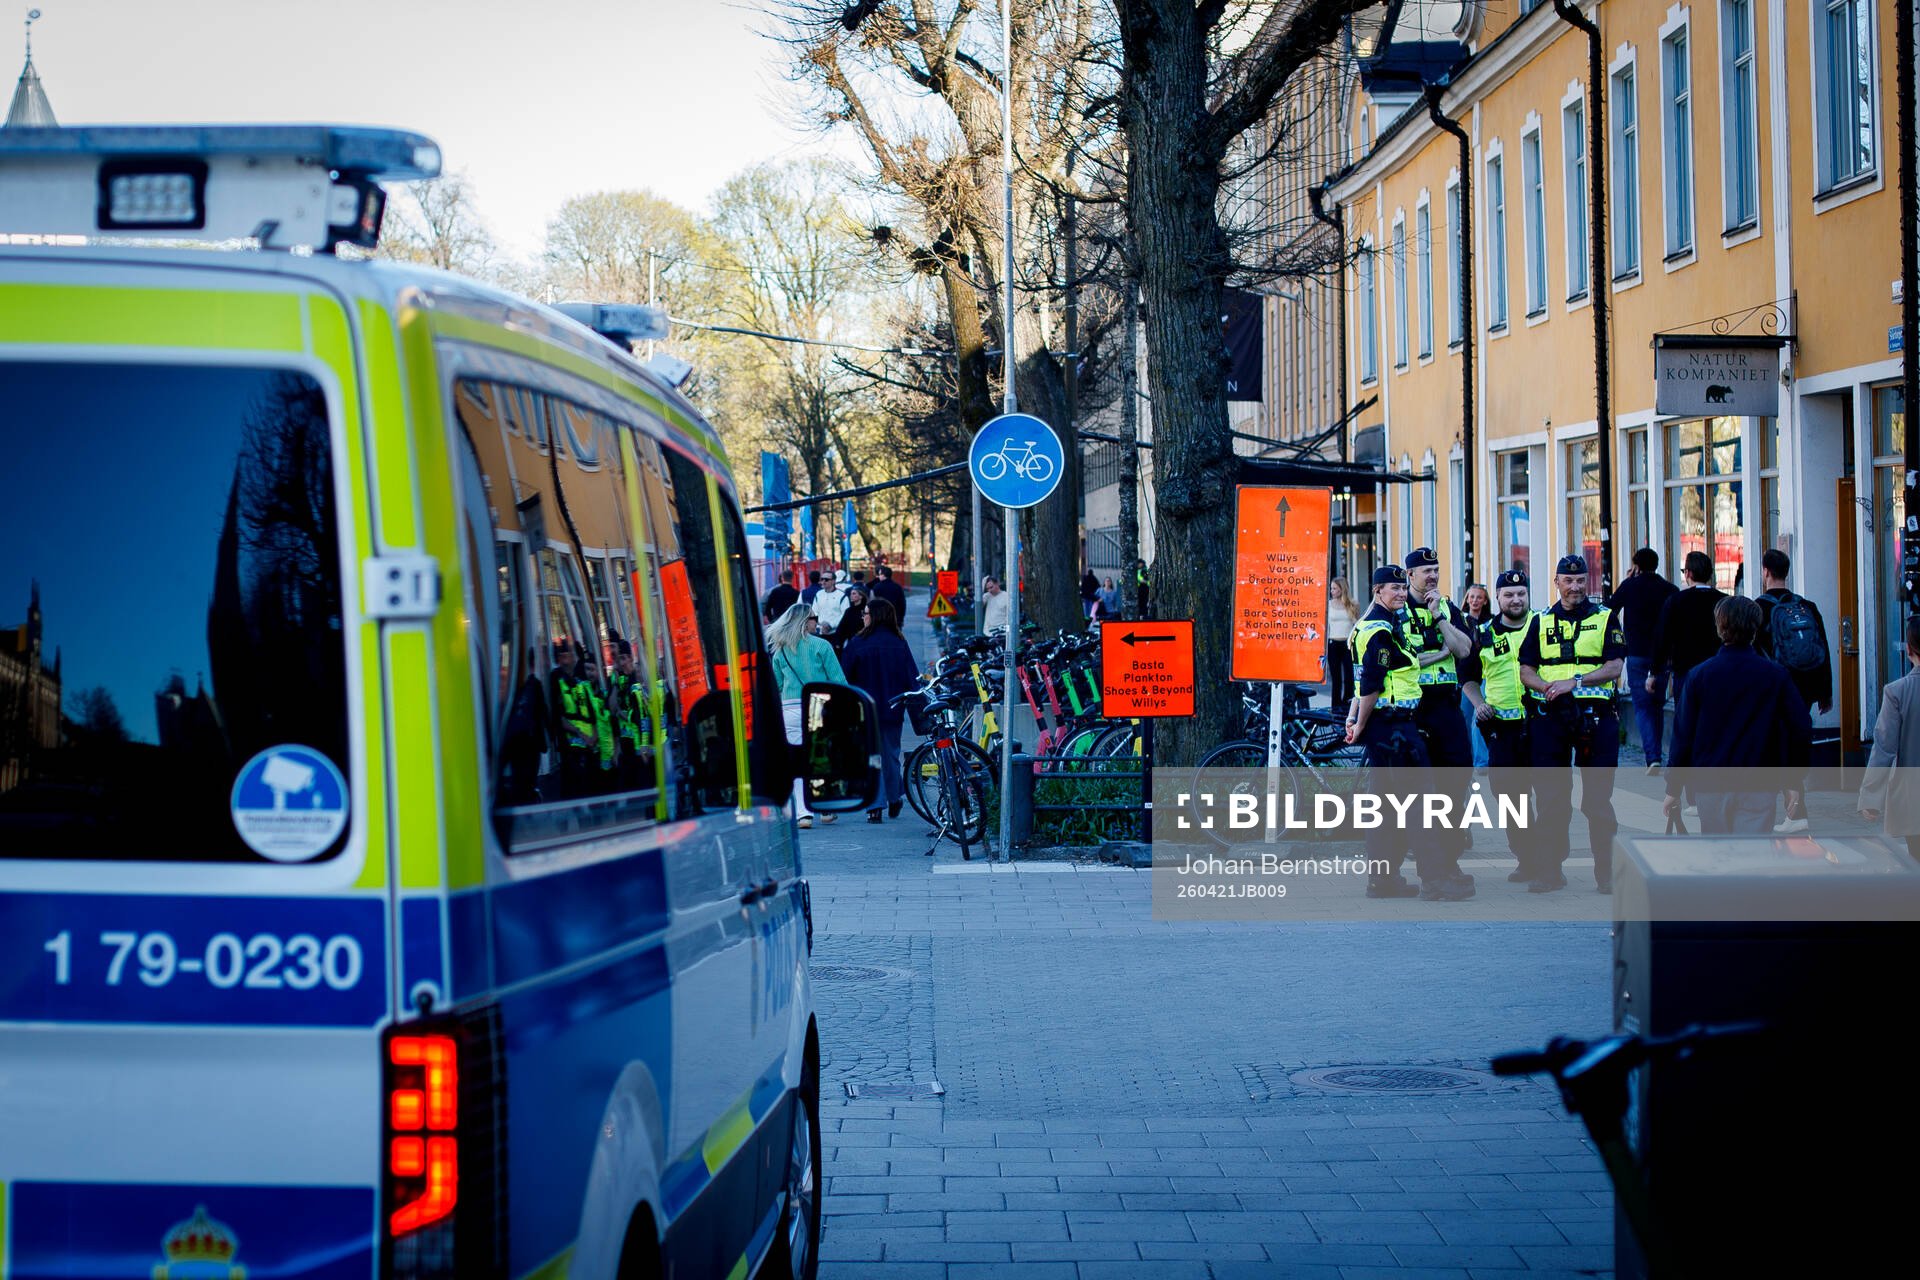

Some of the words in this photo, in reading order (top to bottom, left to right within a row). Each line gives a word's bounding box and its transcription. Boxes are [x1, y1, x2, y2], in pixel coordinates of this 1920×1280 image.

[1689, 352, 1748, 366] NATUR
[1665, 368, 1770, 381] KOMPANIET
[1266, 553, 1298, 563] Willys
[1269, 565, 1295, 573] Vasa
[1248, 574, 1284, 584] Örebro
[1288, 576, 1314, 585] Optik
[1263, 586, 1299, 595] Cirkeln
[1262, 598, 1300, 607] MeiWei
[1244, 609, 1267, 617] Bare
[1271, 609, 1318, 618] Solutions
[1246, 621, 1288, 629] Karolina
[1292, 621, 1316, 631] Berg
[1256, 632, 1305, 642] Jewellery
[1132, 660, 1165, 670] Basta
[1124, 673, 1173, 683] Plankton
[1105, 686, 1137, 696] Shoes
[1141, 686, 1149, 695] &
[1152, 685, 1193, 697] Beyond
[1132, 698, 1167, 708] Willys
[44, 930, 71, 985] 1
[100, 931, 363, 990] 79-0230
